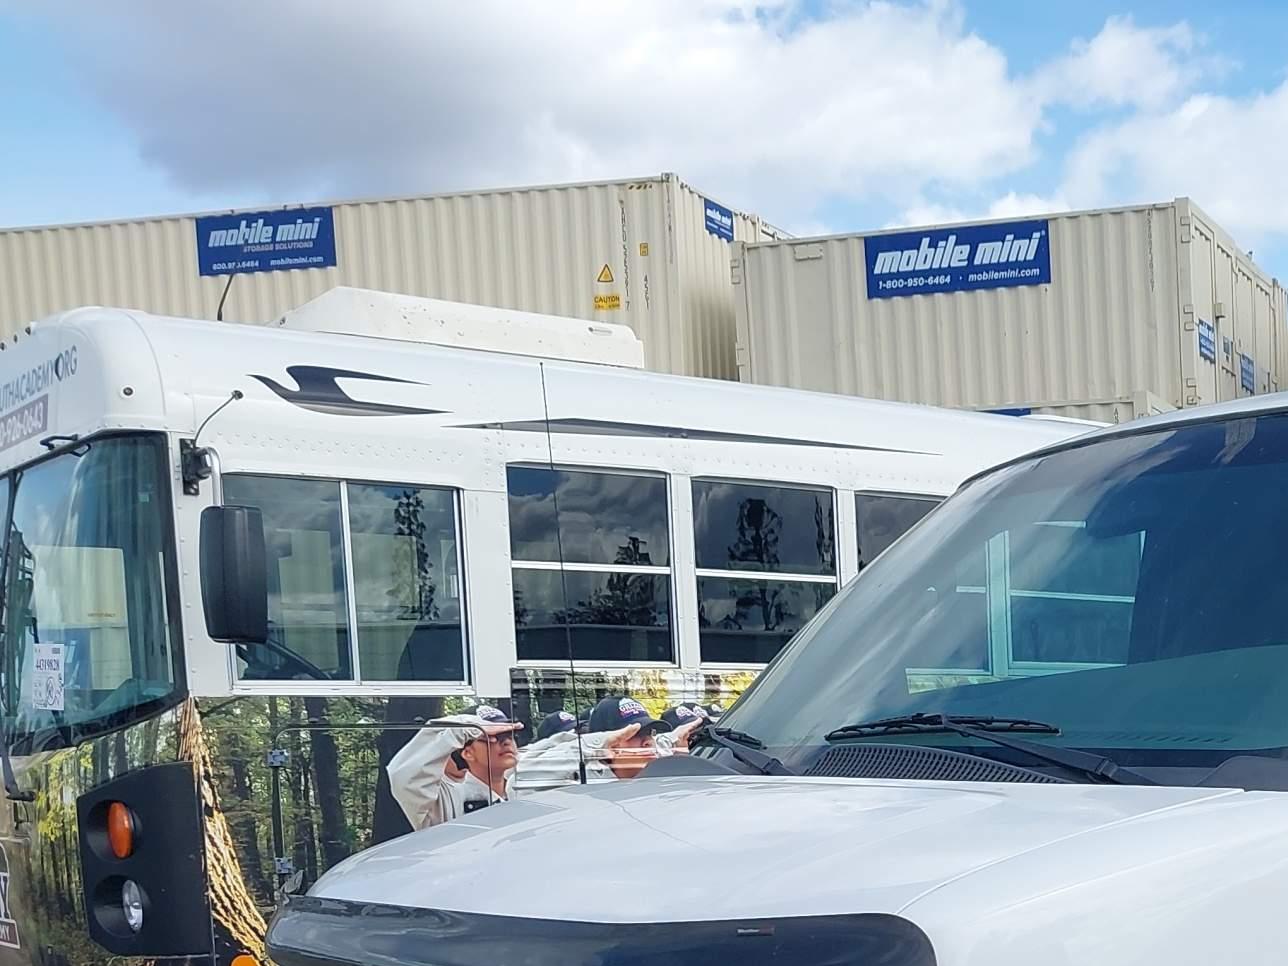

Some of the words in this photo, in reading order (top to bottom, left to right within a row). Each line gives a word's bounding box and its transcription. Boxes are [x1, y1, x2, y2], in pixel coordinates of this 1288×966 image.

[208, 219, 273, 247] mobile
[276, 218, 320, 241] mini
[275, 241, 314, 251] SOLUTIONS
[874, 235, 970, 274] mobile
[974, 232, 1040, 265] mini
[878, 274, 951, 290] 1-800-950-6464
[968, 267, 1040, 282] mobilemini.com
